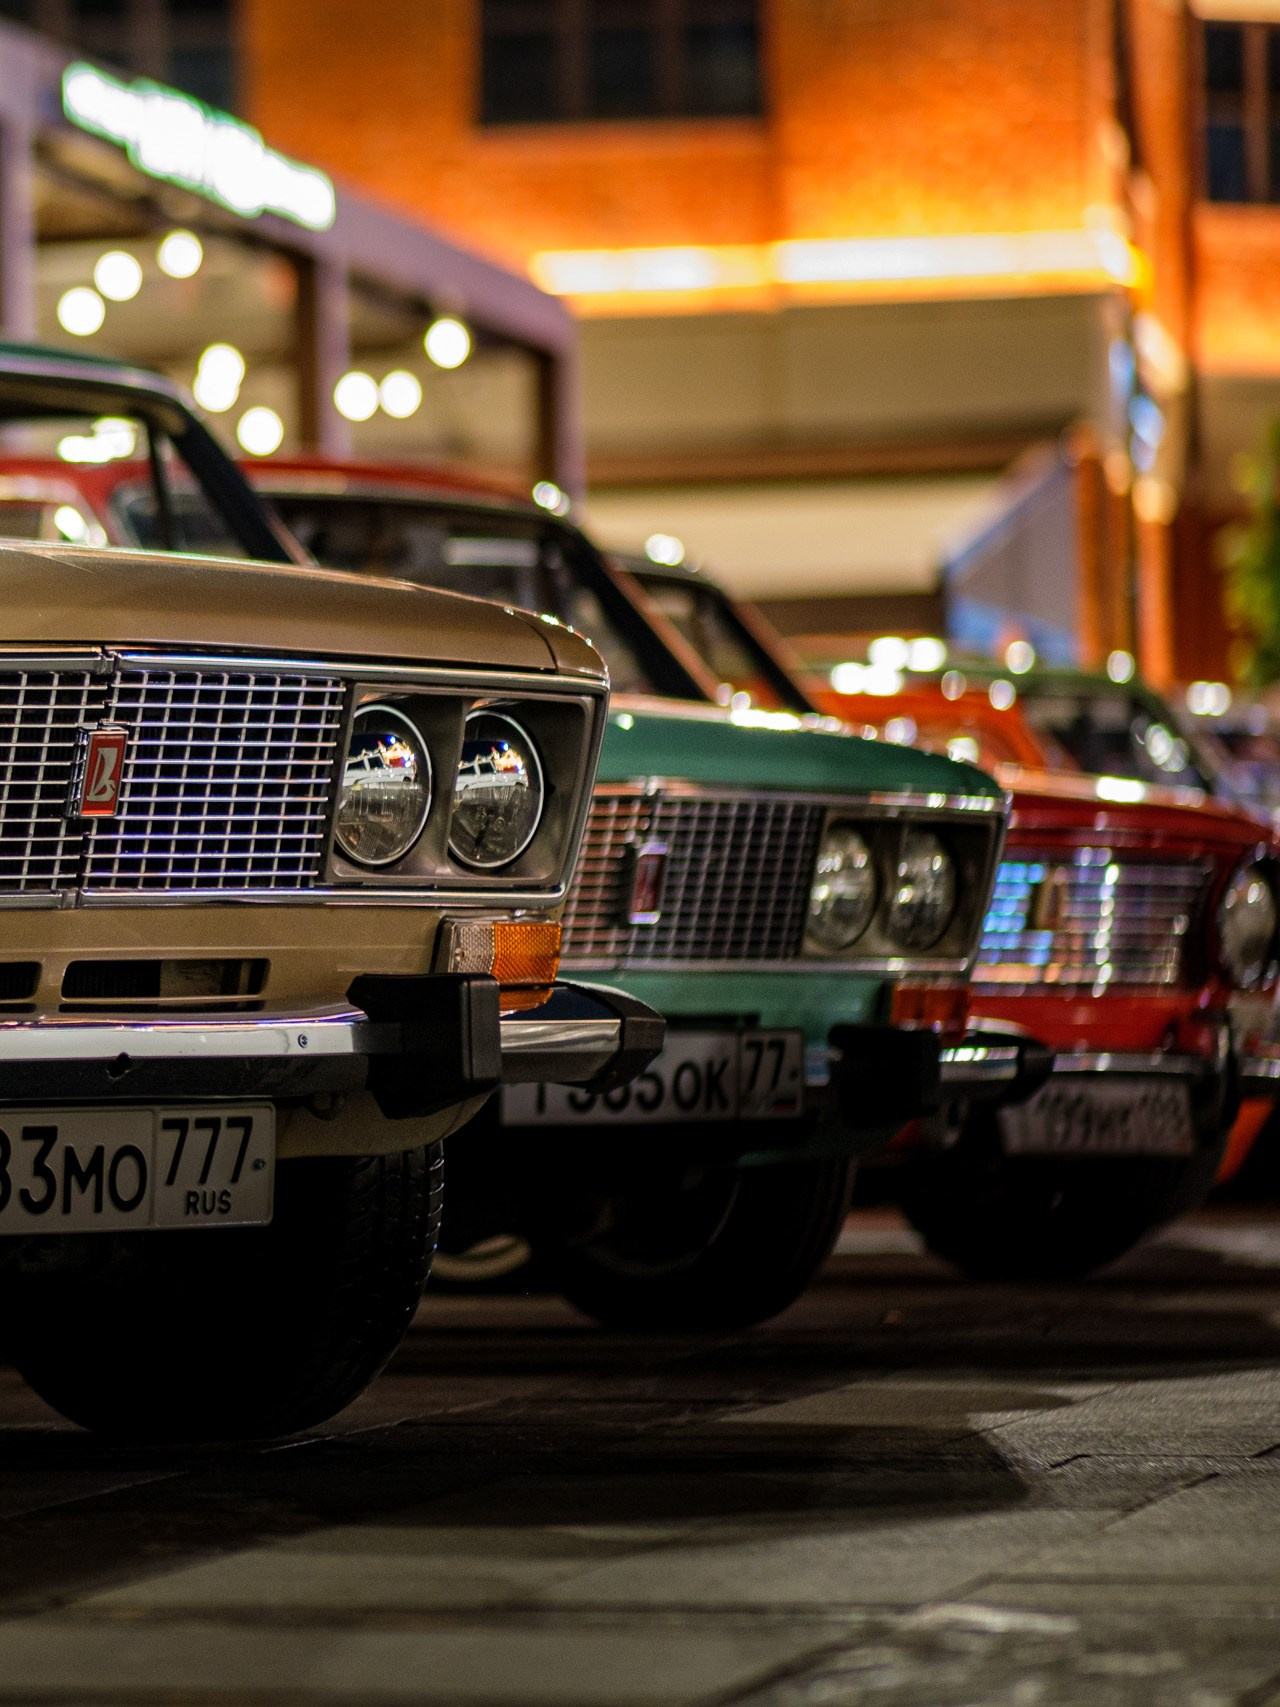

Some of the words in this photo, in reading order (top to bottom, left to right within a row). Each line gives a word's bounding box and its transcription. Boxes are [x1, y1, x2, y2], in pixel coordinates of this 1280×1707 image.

[745, 1040, 786, 1092] 77
[162, 1115, 253, 1186] 777
[185, 1189, 231, 1215] RUS
